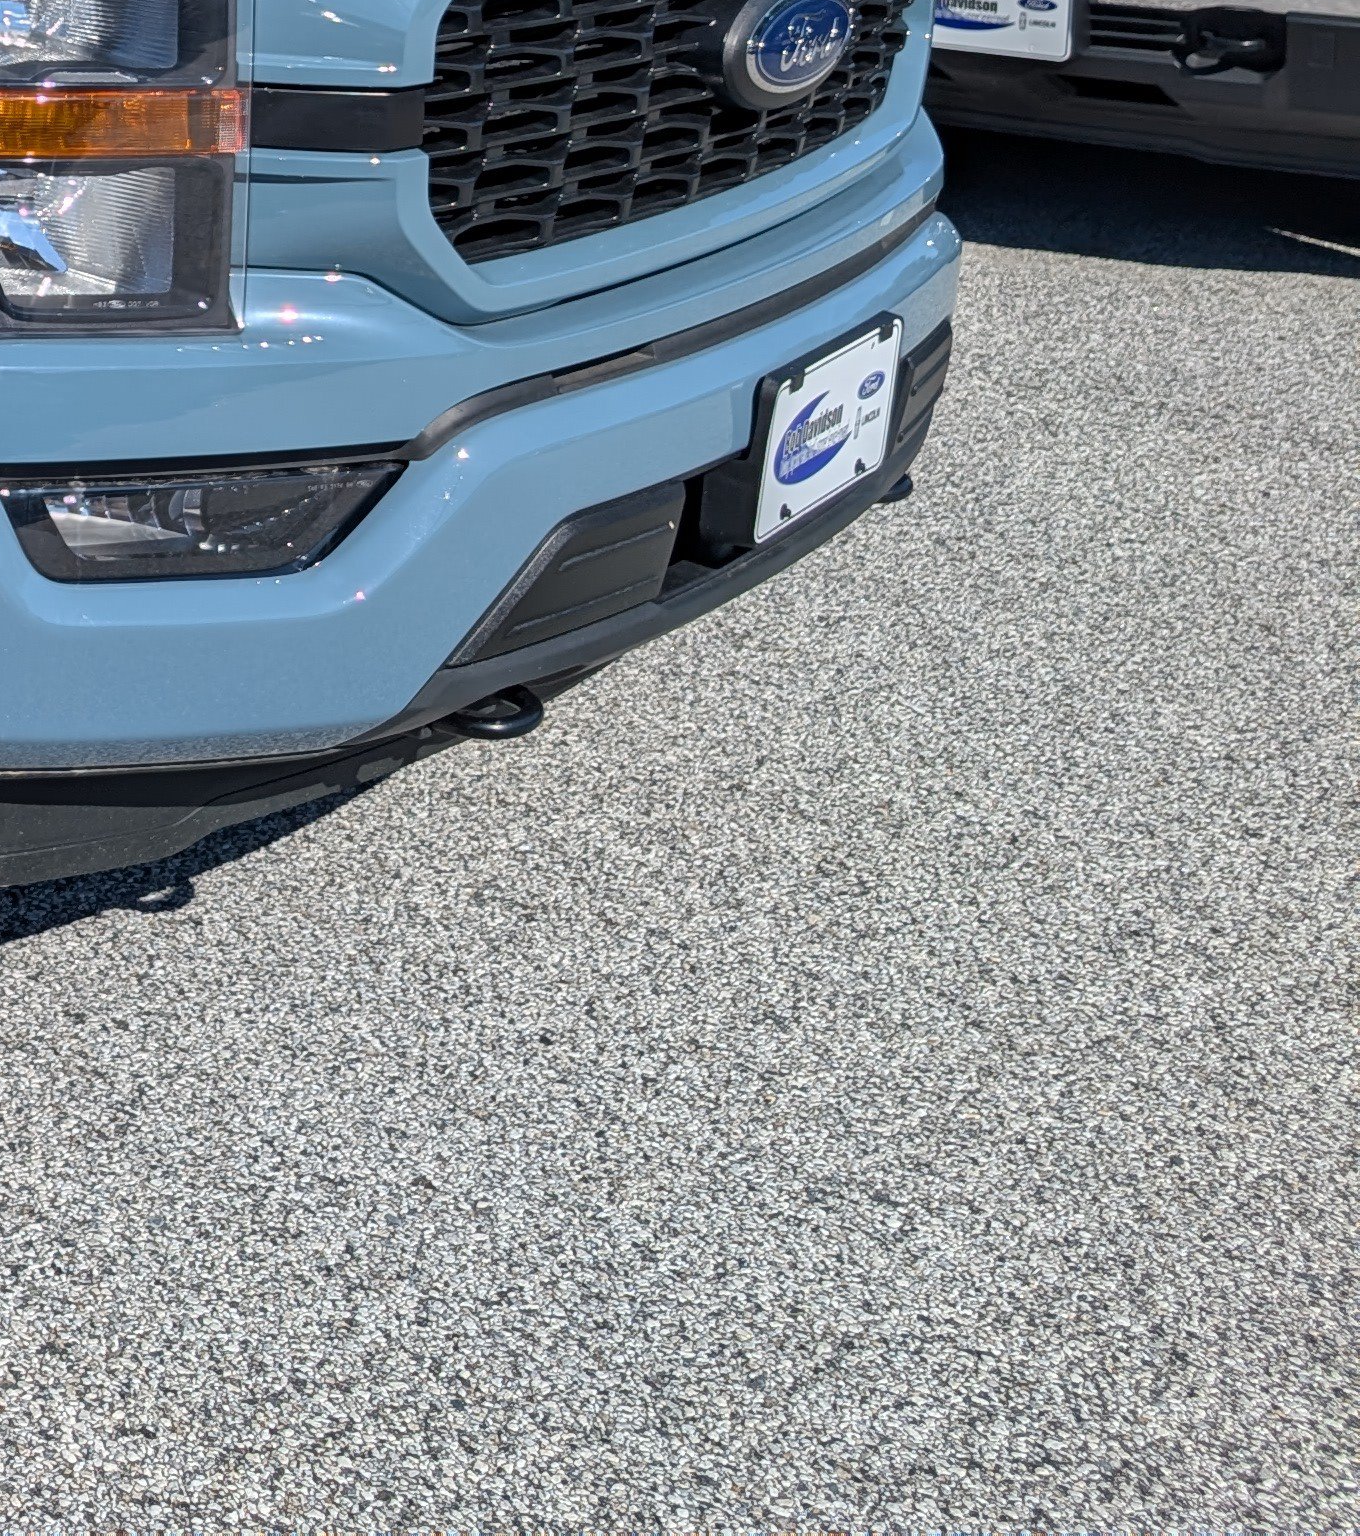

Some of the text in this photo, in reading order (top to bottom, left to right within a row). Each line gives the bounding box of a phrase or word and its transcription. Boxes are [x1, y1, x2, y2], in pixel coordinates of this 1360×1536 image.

[771, 7, 844, 73] Ford
[782, 403, 844, 459] Bob Davidson
